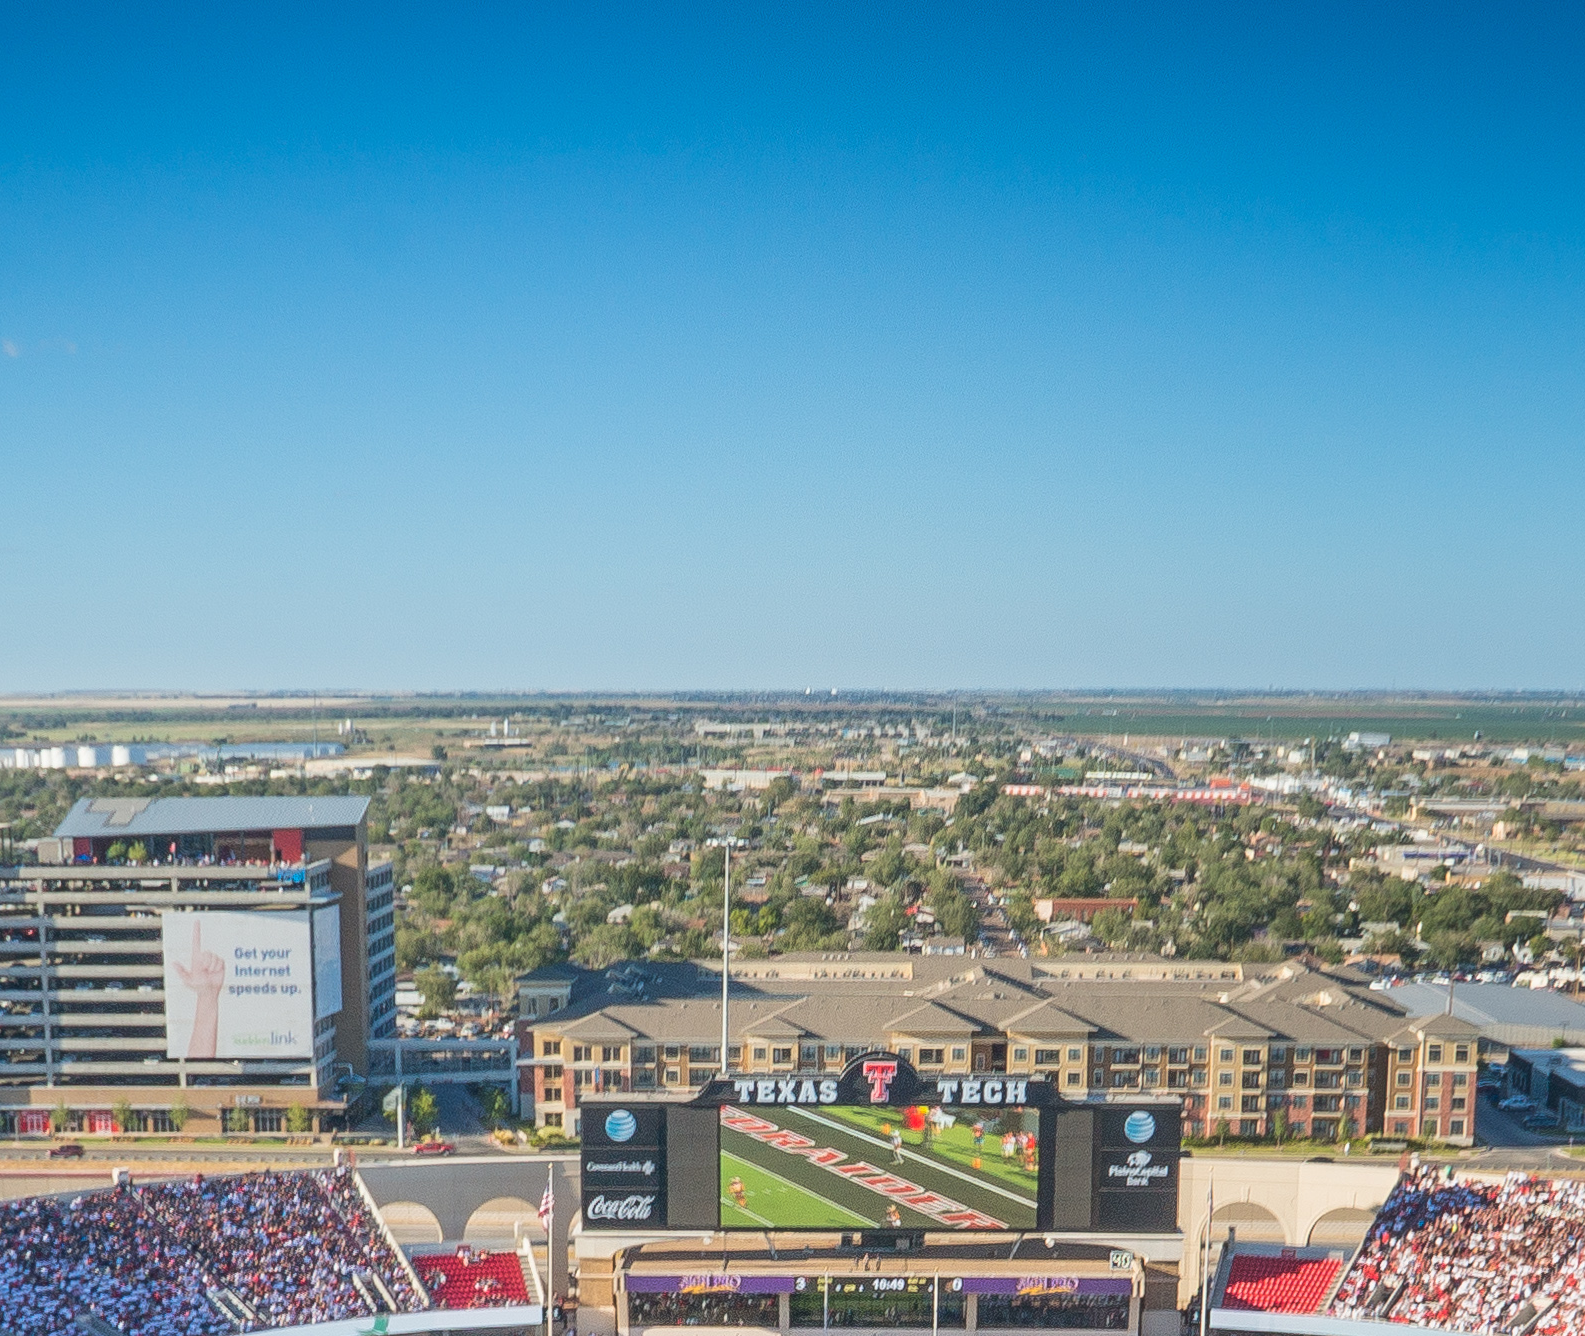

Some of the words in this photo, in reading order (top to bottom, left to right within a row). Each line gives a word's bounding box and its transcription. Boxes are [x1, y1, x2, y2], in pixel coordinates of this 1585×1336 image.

[235, 946, 258, 960] Get
[261, 948, 292, 962] your
[234, 964, 292, 978] Internet
[228, 983, 277, 997] speeds
[280, 983, 303, 997] up.
[733, 1078, 838, 1104] TEXAS
[936, 1079, 1028, 1105] TECH
[1126, 1176, 1150, 1188] Bank
